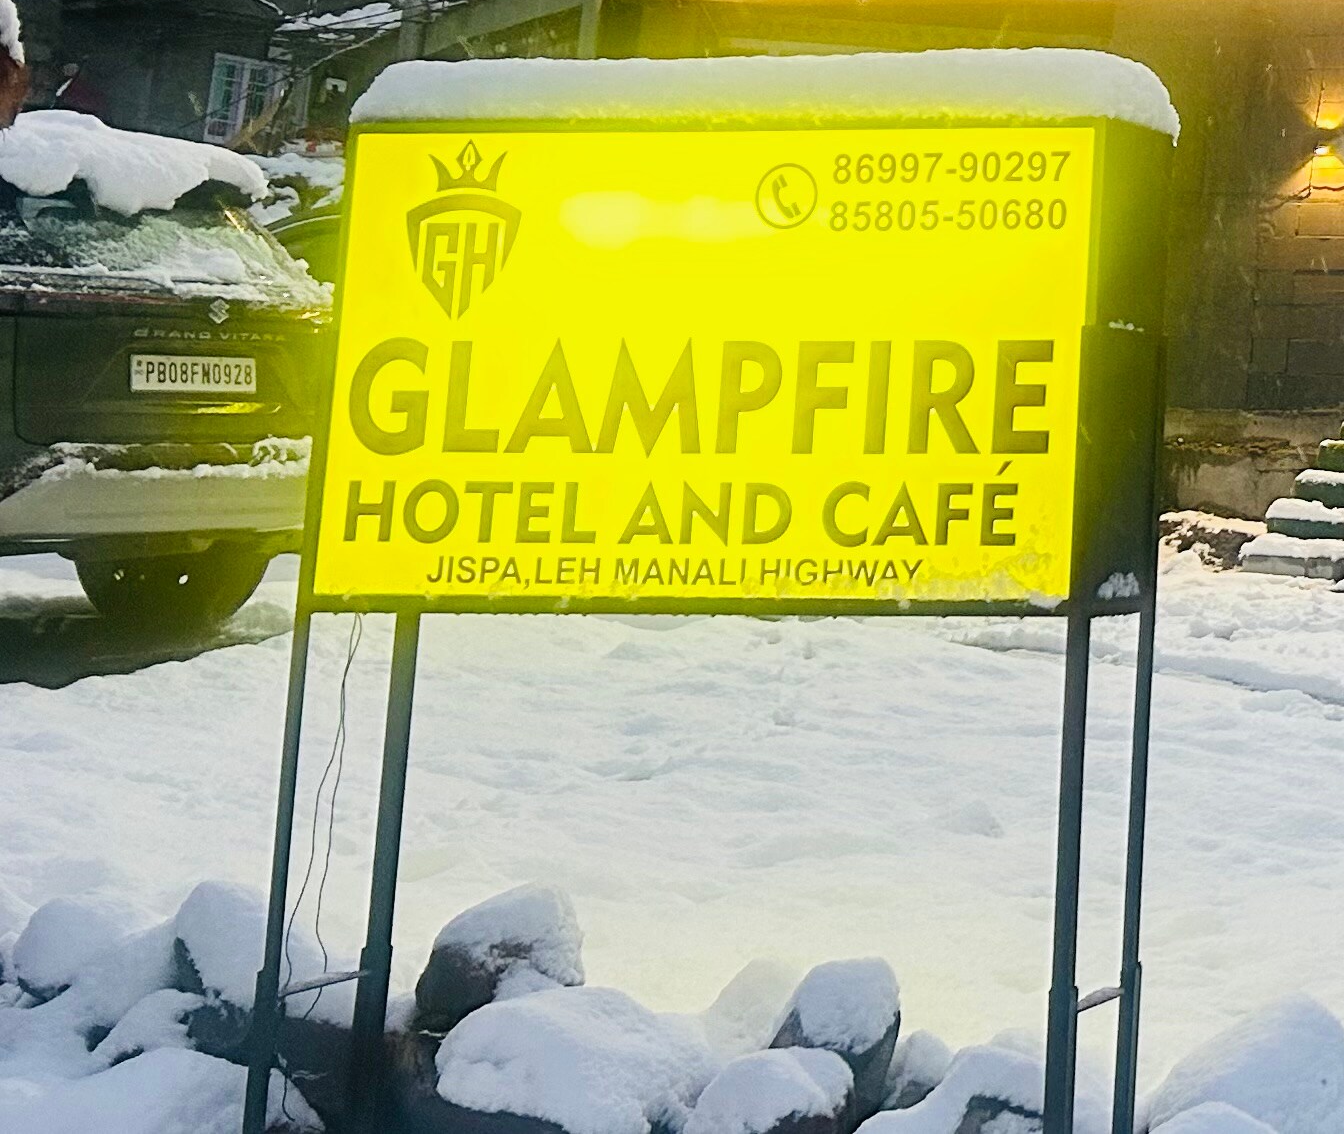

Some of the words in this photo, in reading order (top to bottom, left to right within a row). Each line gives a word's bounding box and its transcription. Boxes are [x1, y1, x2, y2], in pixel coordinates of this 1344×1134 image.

[832, 150, 1072, 187] 86997-90297
[828, 197, 1069, 233] 85805-50680
[348, 336, 1056, 460] GLAMPFIRE
[342, 478, 598, 545] HOTEL
[617, 478, 793, 548] AND
[822, 461, 1020, 548] CAFÉ
[614, 557, 748, 586] MANALI
[759, 558, 925, 586] HIGHWAY
